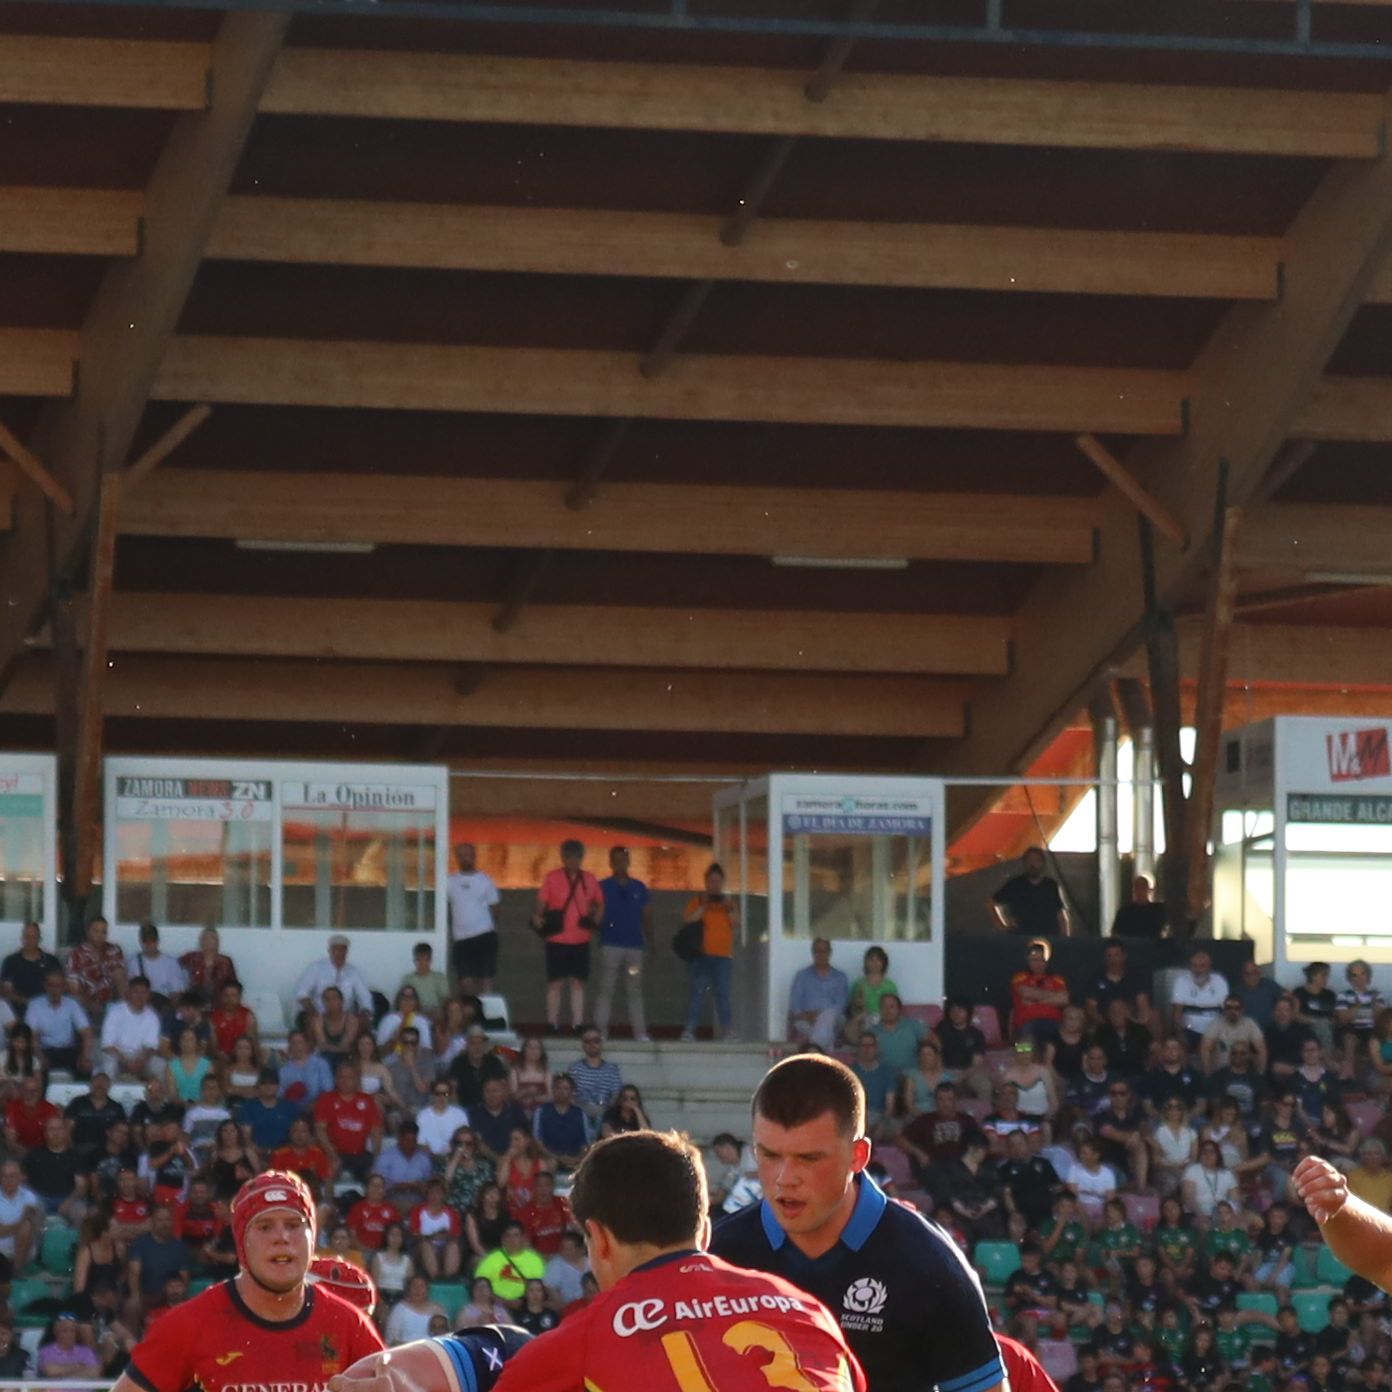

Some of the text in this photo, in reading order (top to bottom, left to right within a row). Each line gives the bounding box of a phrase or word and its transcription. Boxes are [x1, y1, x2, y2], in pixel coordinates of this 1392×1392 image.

[123, 778, 183, 799] ZAMORA
[303, 784, 417, 808] La Opinión
[1290, 801, 1353, 821] GRANDE
[674, 1292, 806, 1321] AirEuropa
[840, 1313, 884, 1326] SCOTLAND
